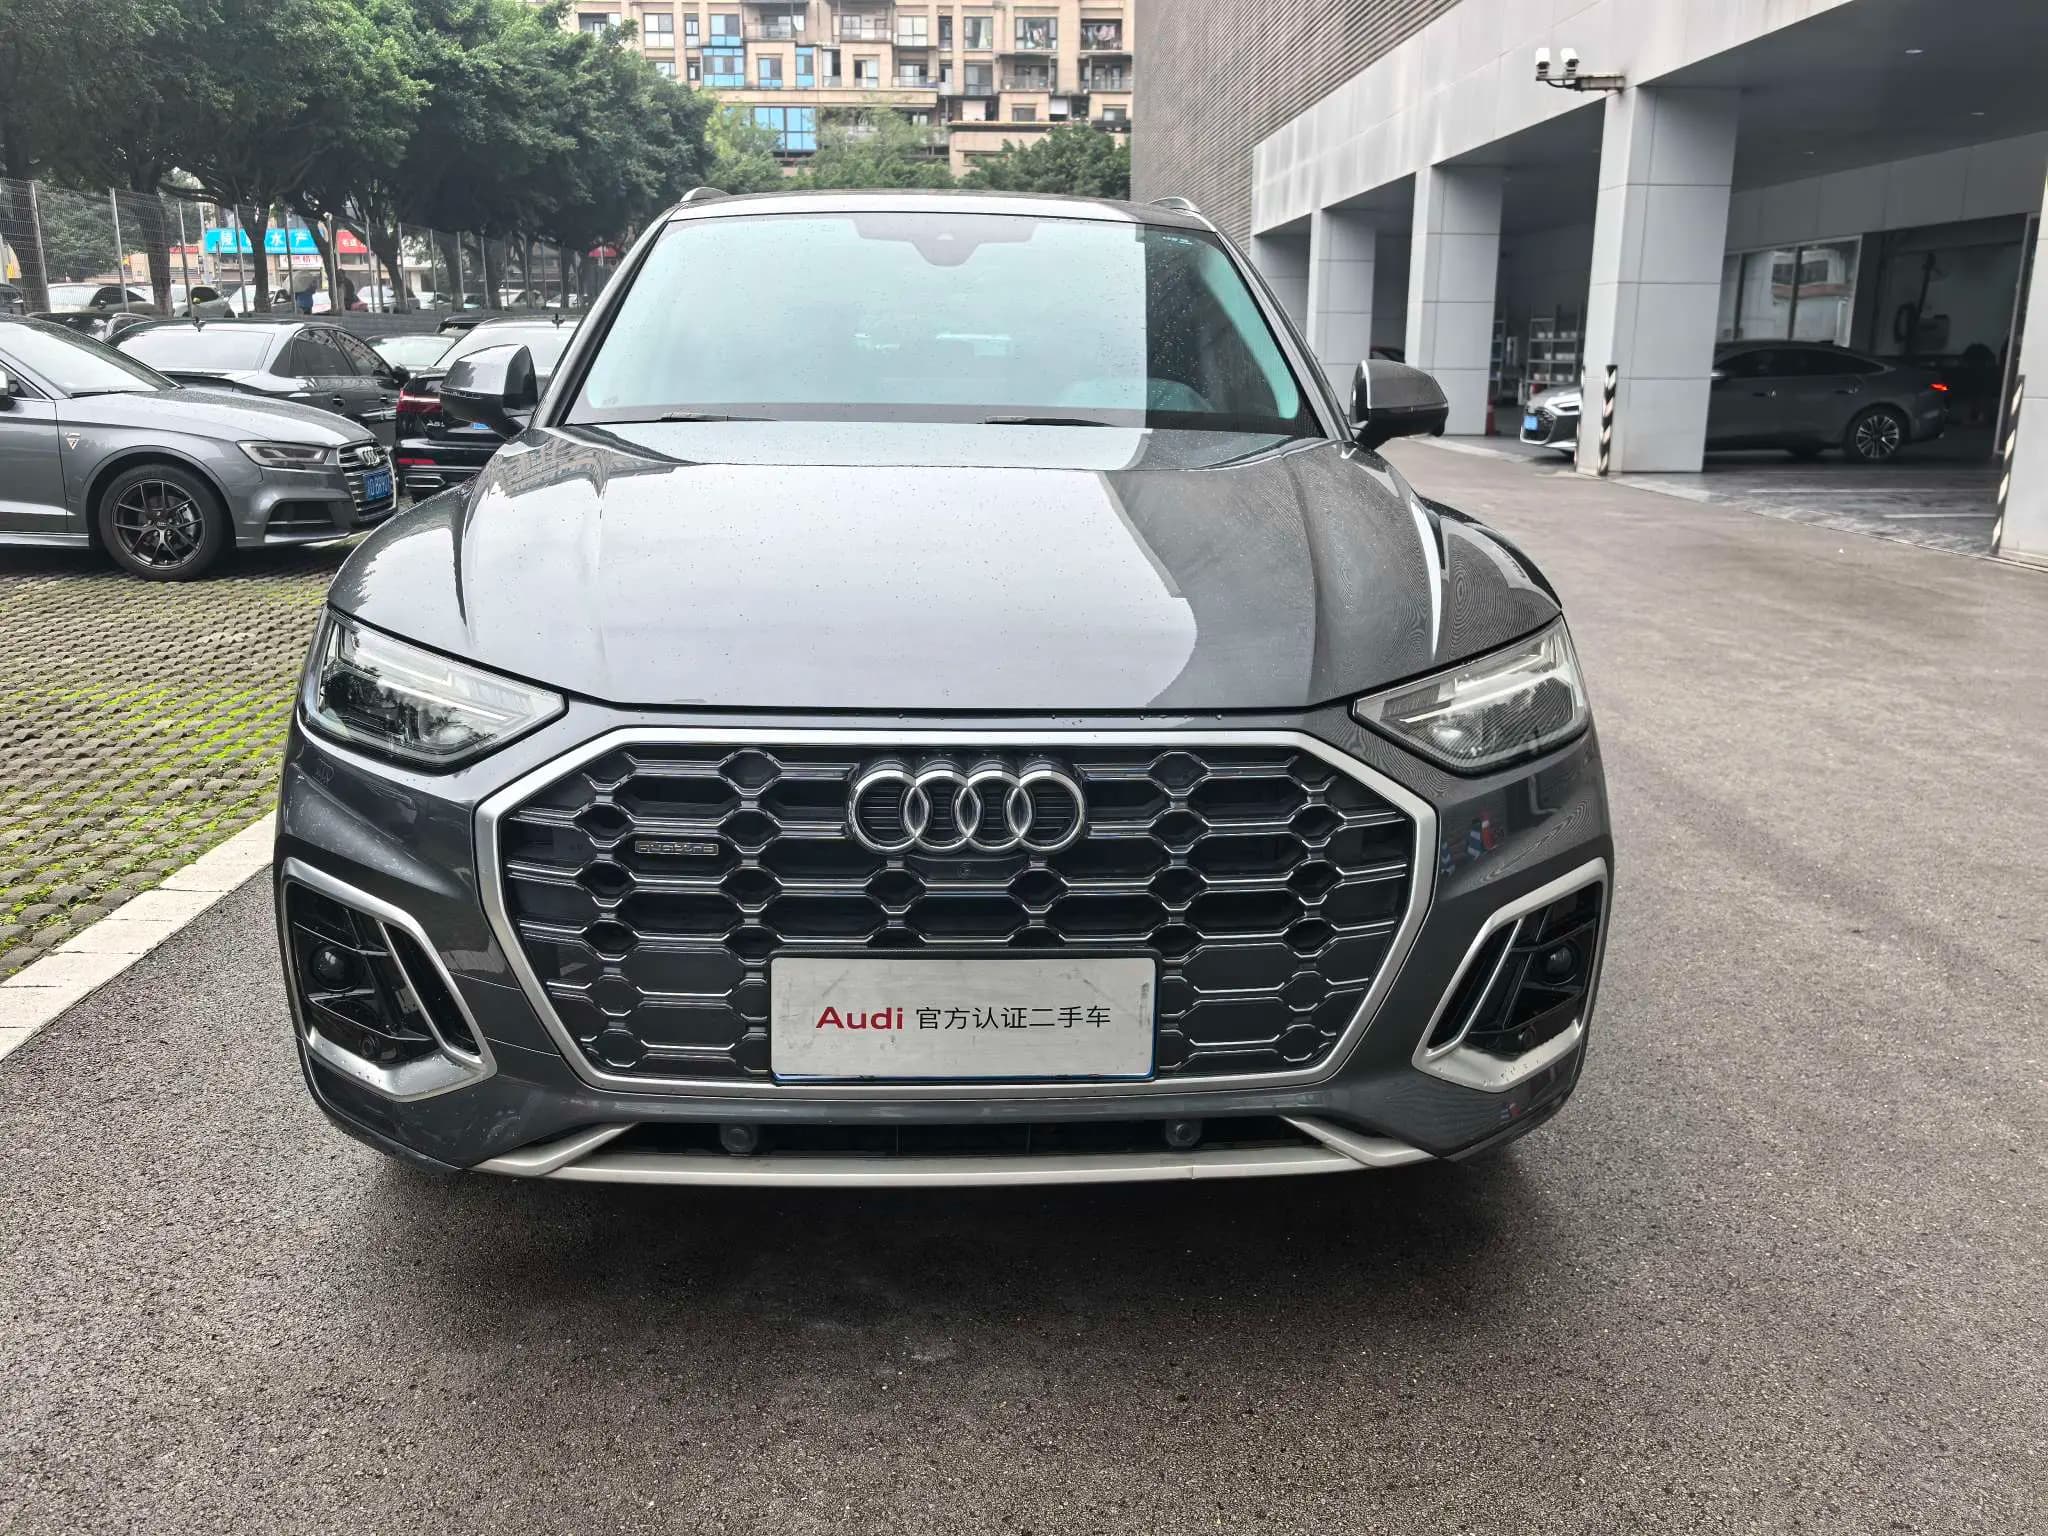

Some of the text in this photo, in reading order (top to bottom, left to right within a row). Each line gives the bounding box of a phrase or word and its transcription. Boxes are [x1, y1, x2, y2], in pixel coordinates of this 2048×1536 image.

[815, 1005, 1111, 1030] Audi 官方认证二手车
